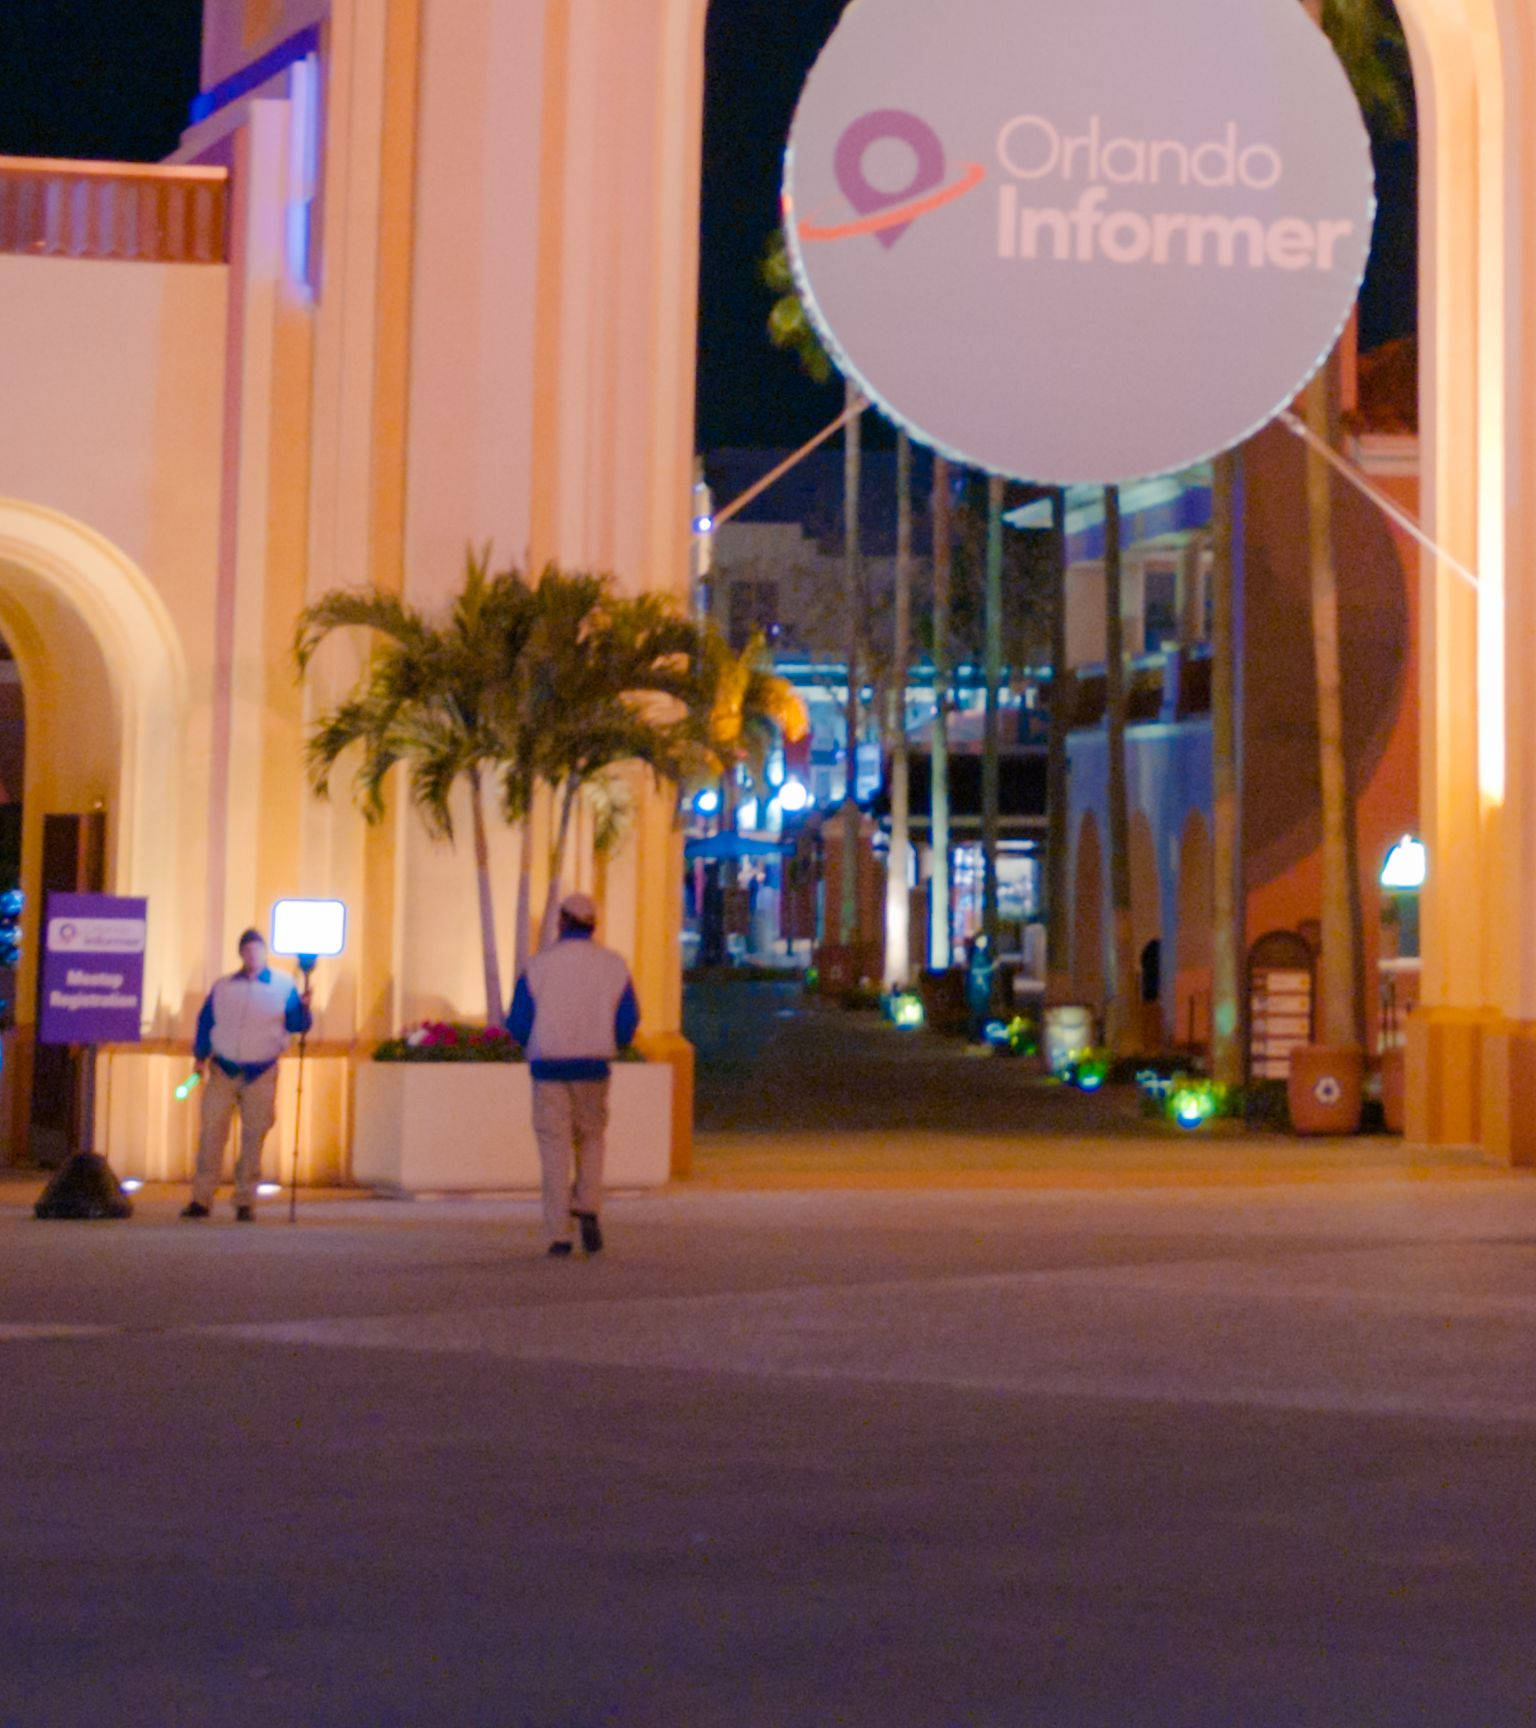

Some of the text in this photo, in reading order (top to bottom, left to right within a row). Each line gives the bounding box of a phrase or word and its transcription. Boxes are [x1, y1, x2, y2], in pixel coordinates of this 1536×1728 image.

[996, 114, 1282, 189] Orlando
[997, 184, 1354, 270] Informer
[49, 990, 138, 1011] Registration
